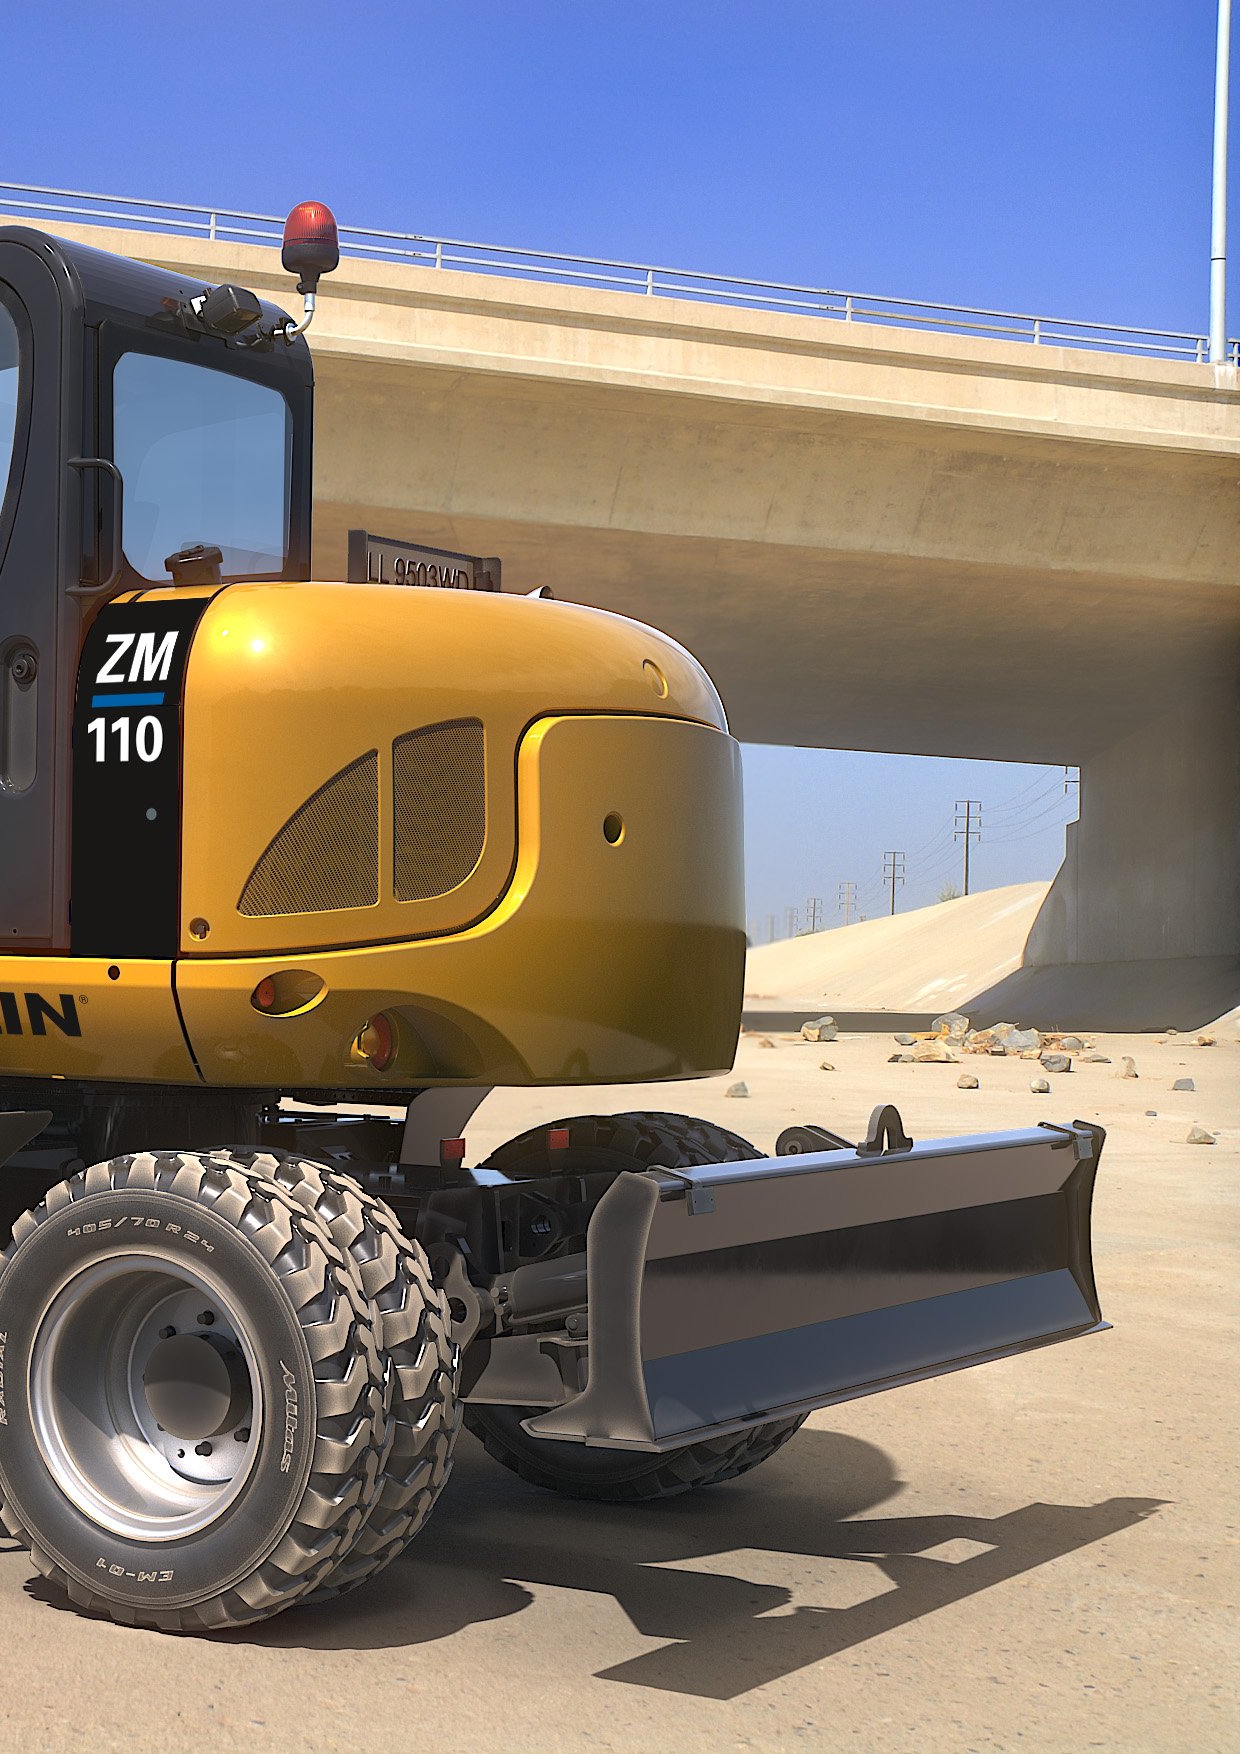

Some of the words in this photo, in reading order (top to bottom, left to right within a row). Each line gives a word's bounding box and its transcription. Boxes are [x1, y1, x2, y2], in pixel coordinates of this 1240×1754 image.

[95, 630, 180, 684] ZM
[87, 715, 164, 763] 110
[67, 1216, 161, 1237] 405/70
[165, 1222, 182, 1235] R
[183, 1230, 215, 1253] 24
[96, 1557, 174, 1582] EM-01
